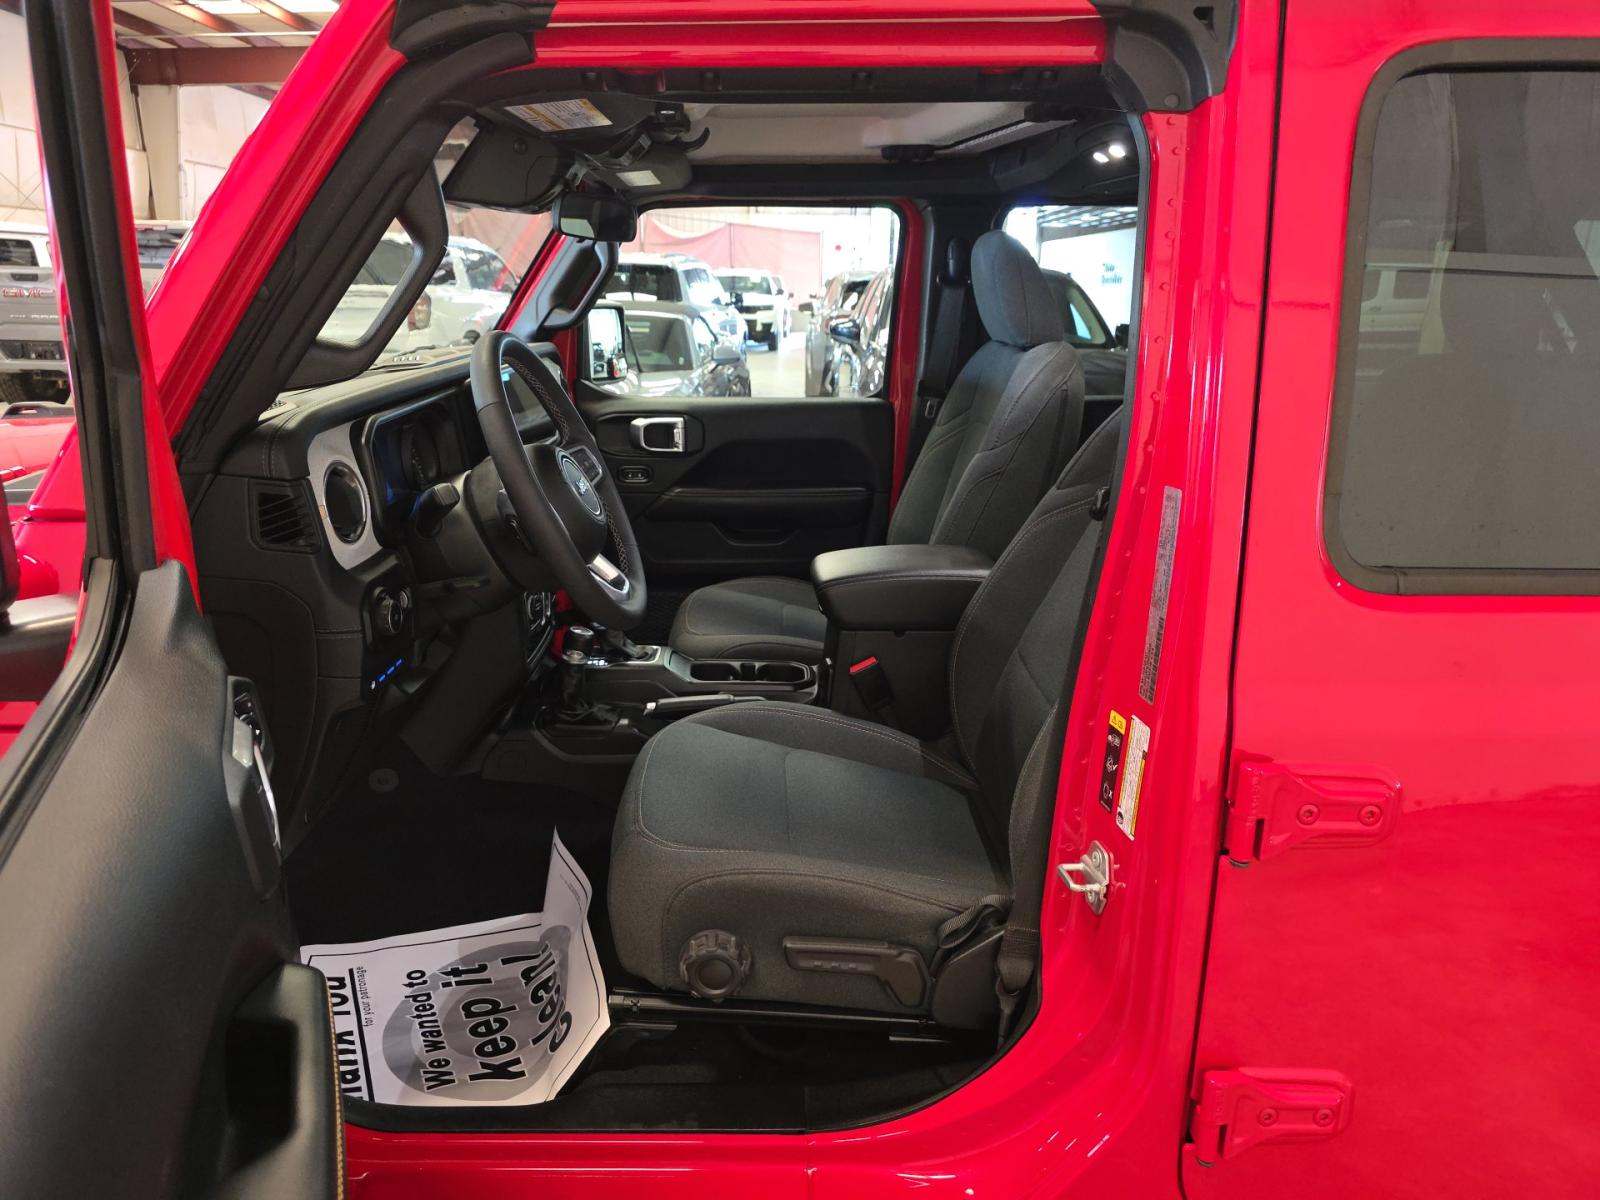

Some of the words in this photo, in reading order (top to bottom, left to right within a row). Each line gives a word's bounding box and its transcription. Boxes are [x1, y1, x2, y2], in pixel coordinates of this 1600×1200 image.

[356, 966, 372, 1000] patronage
[403, 969, 427, 989] to
[439, 962, 495, 989] it
[361, 1000, 375, 1016] your
[501, 942, 572, 1053] clean!
[404, 992, 447, 1053] wanted
[461, 997, 527, 1083] keep
[337, 1029, 368, 1101] ank
[422, 1057, 456, 1092] We
